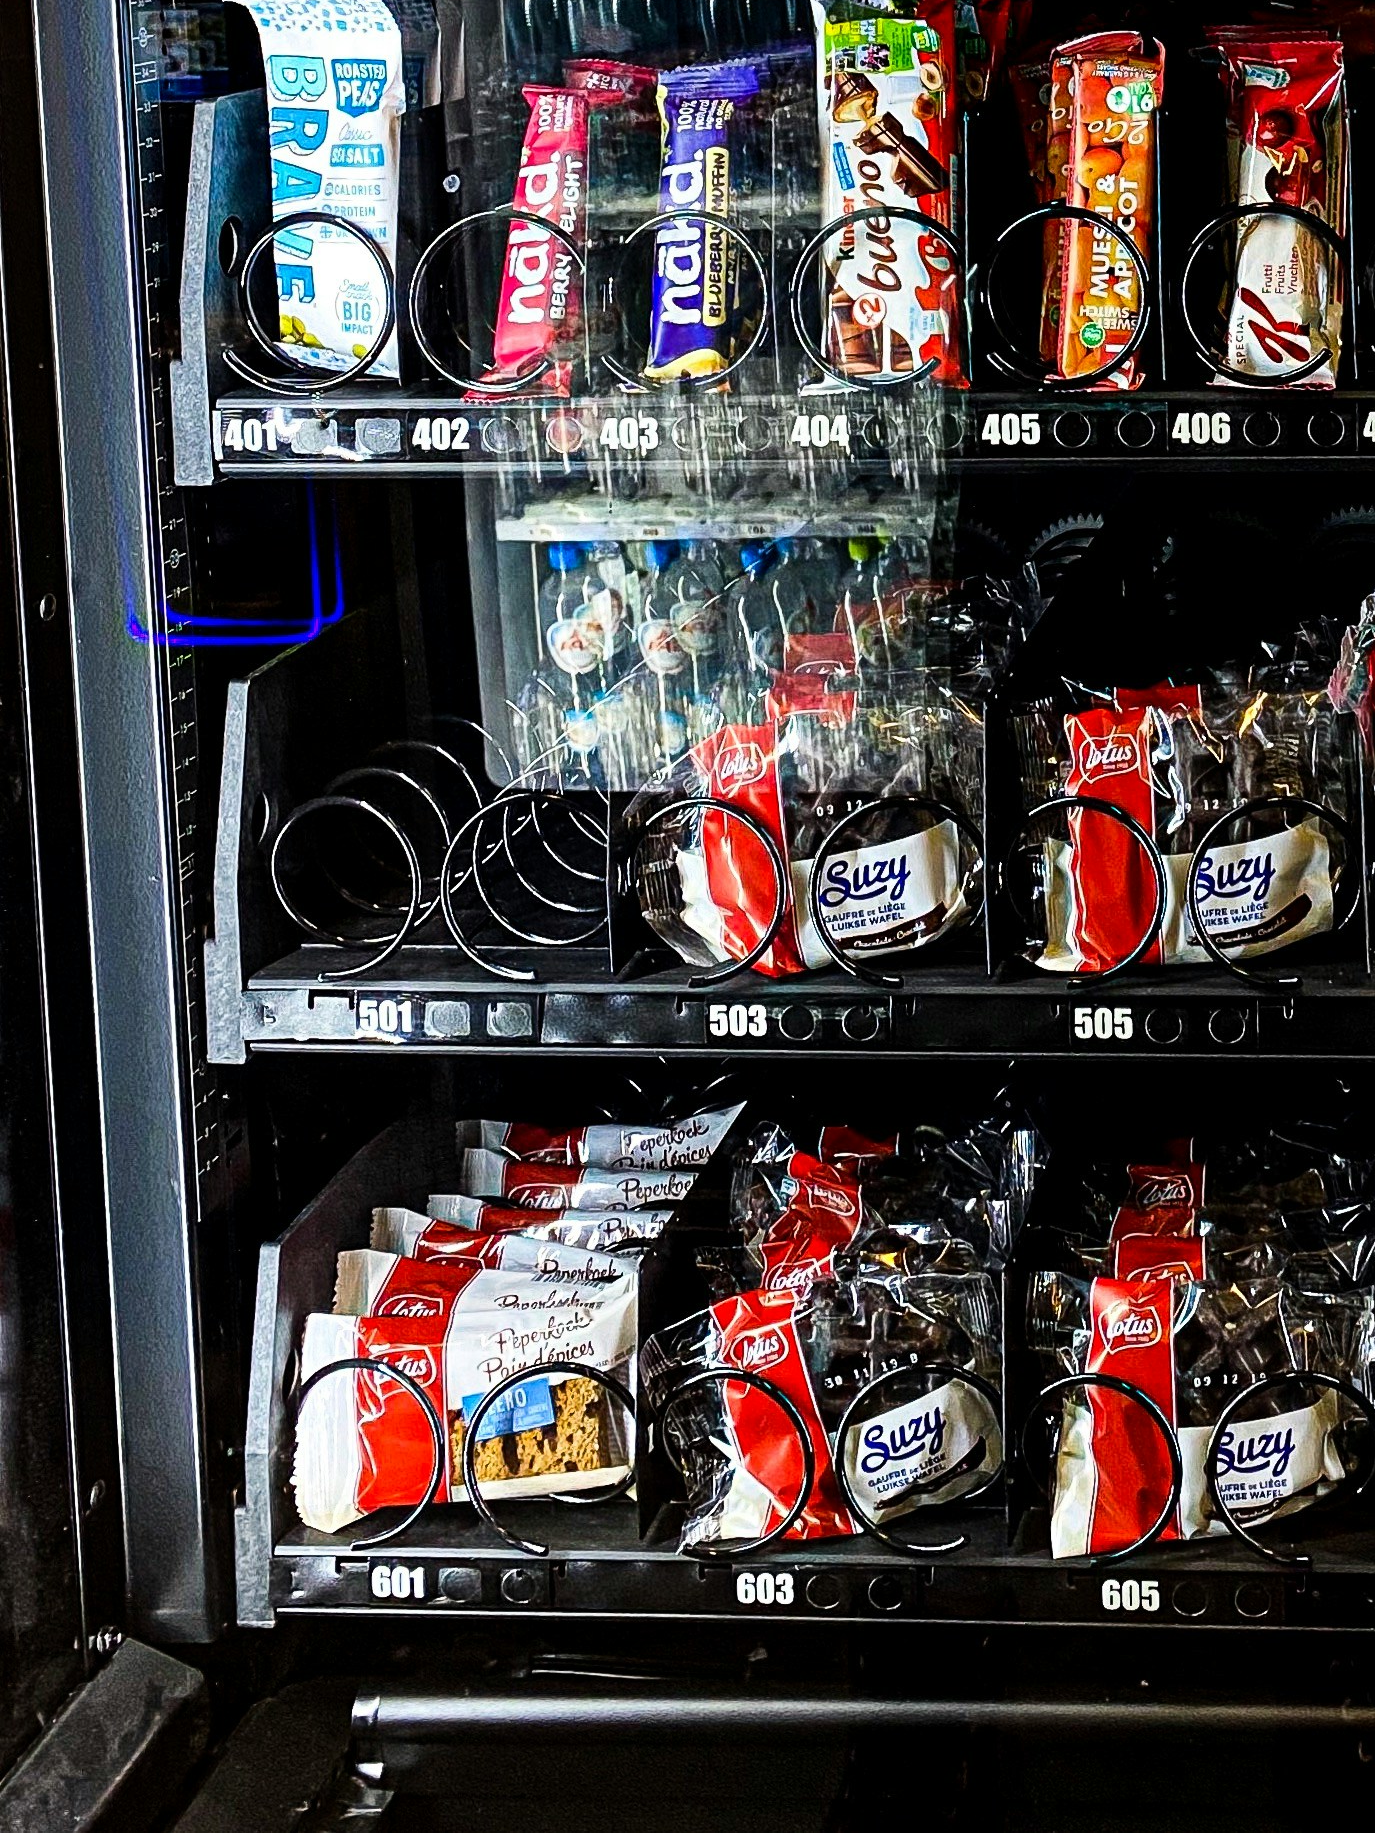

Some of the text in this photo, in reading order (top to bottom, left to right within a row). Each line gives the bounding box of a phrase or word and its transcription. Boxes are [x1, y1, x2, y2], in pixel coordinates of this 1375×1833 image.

[335, 61, 387, 80] ROASTED
[339, 78, 382, 111] PEAS
[346, 145, 383, 166] SALT
[267, 54, 329, 305] BRAVE
[335, 183, 382, 199] CALORIES
[710, 151, 728, 217] MUFFIN
[334, 206, 377, 222] PROTEIN
[857, 158, 903, 294] bueno
[1111, 178, 1139, 300] APRICOT
[548, 251, 573, 321] BERRY
[1260, 264, 1272, 296] Frutti
[1273, 264, 1286, 296] Fruits
[1286, 247, 1299, 297] Vruchten
[343, 298, 373, 324] BIG
[341, 323, 374, 338] IMPACT
[1234, 313, 1246, 366] SPECIAL
[225, 418, 278, 451] 401
[412, 417, 470, 451] 402
[600, 417, 659, 451] 403
[790, 414, 850, 447] 404
[981, 413, 1041, 445] 405
[1171, 412, 1231, 444] 406
[1085, 741, 1133, 771] lotus
[819, 854, 911, 910] Suzy
[1196, 852, 1278, 906] Suzy
[830, 912, 905, 932] LUIKSE WAFEL
[1231, 911, 1266, 925] WAFEL
[359, 1001, 414, 1033] 501
[709, 1004, 768, 1037] 503
[1073, 1007, 1133, 1040] 505
[494, 1311, 595, 1355] Peperkoek
[861, 1406, 946, 1475] Suzy
[1208, 1426, 1295, 1477] Suzy
[372, 1566, 425, 1600] 601
[737, 1573, 795, 1606] 603
[1102, 1580, 1161, 1612] 605
